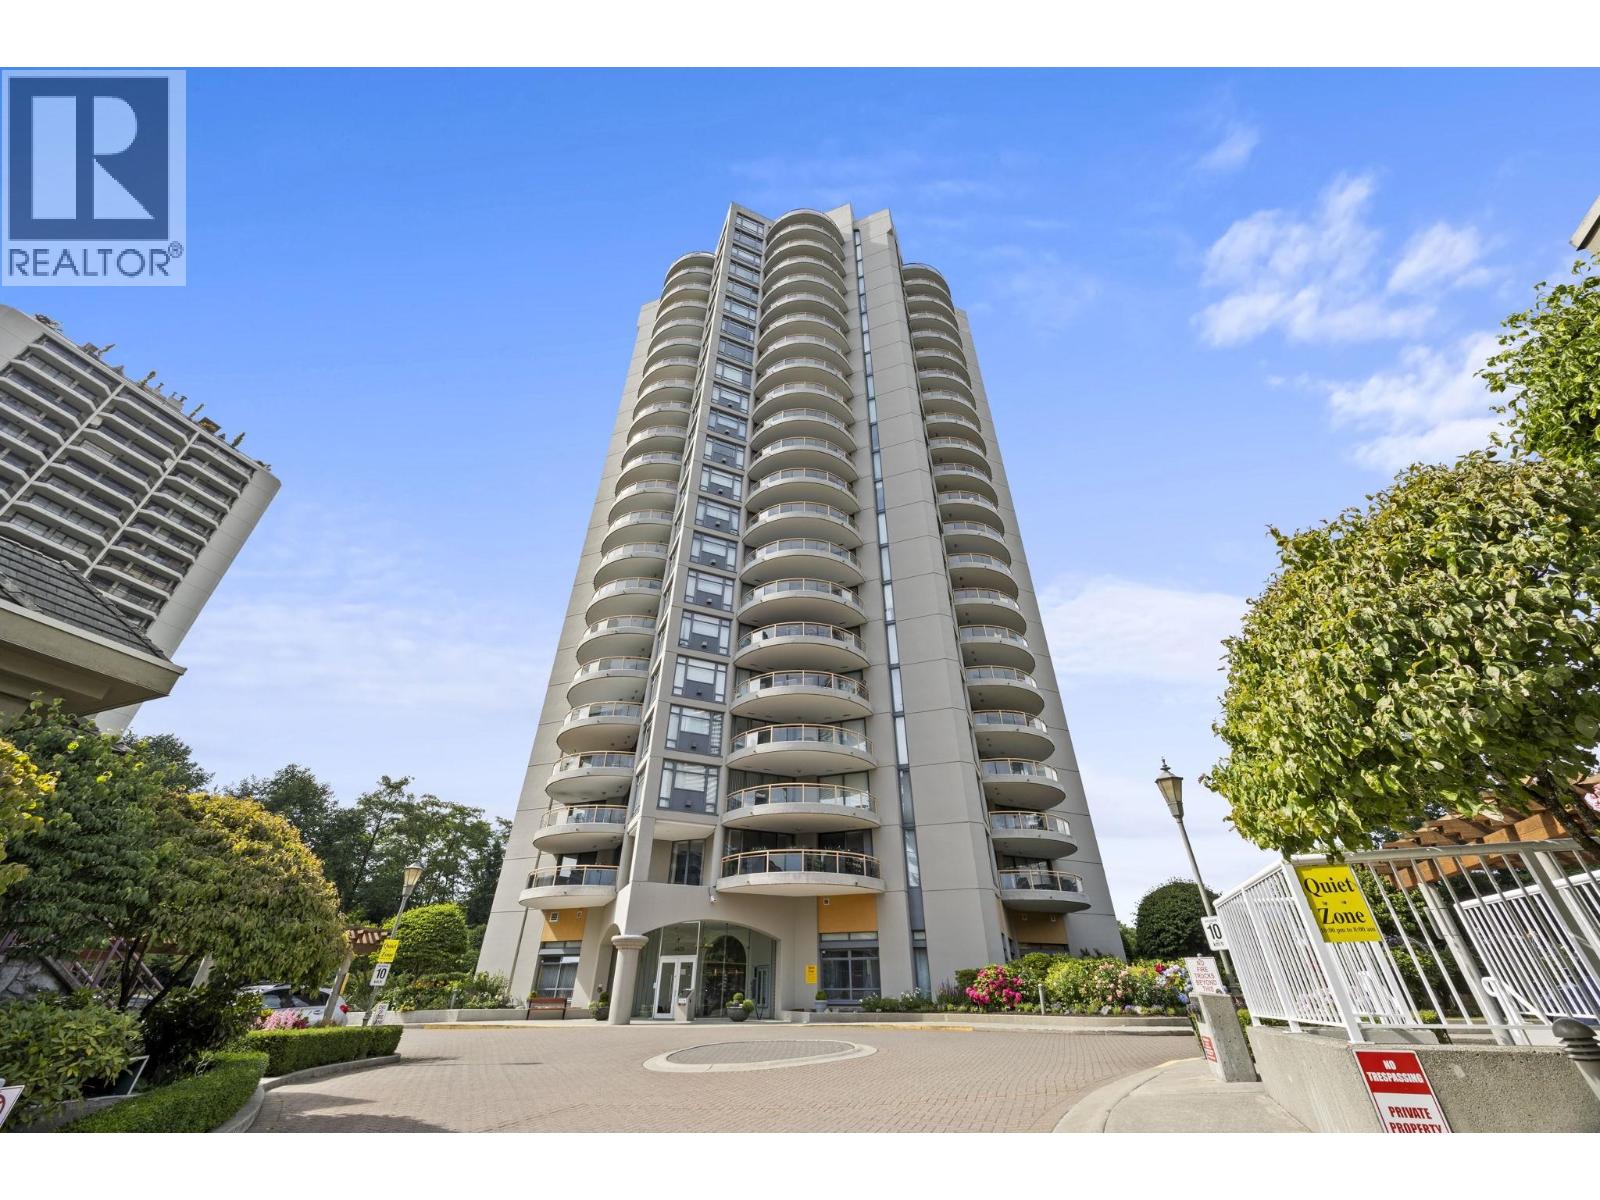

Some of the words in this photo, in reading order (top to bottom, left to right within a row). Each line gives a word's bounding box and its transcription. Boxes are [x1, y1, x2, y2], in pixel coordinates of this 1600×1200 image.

[1304, 877, 1354, 897] Quiet
[1317, 907, 1366, 925] Zone
[1207, 923, 1222, 940] 10
[376, 967, 387, 979] 10
[1382, 1059, 1397, 1070] NO
[1366, 1072, 1424, 1083] TRESPASSING
[1388, 1106, 1432, 1119] PRIVATE
[1389, 1122, 1441, 1133] PROPERTY
